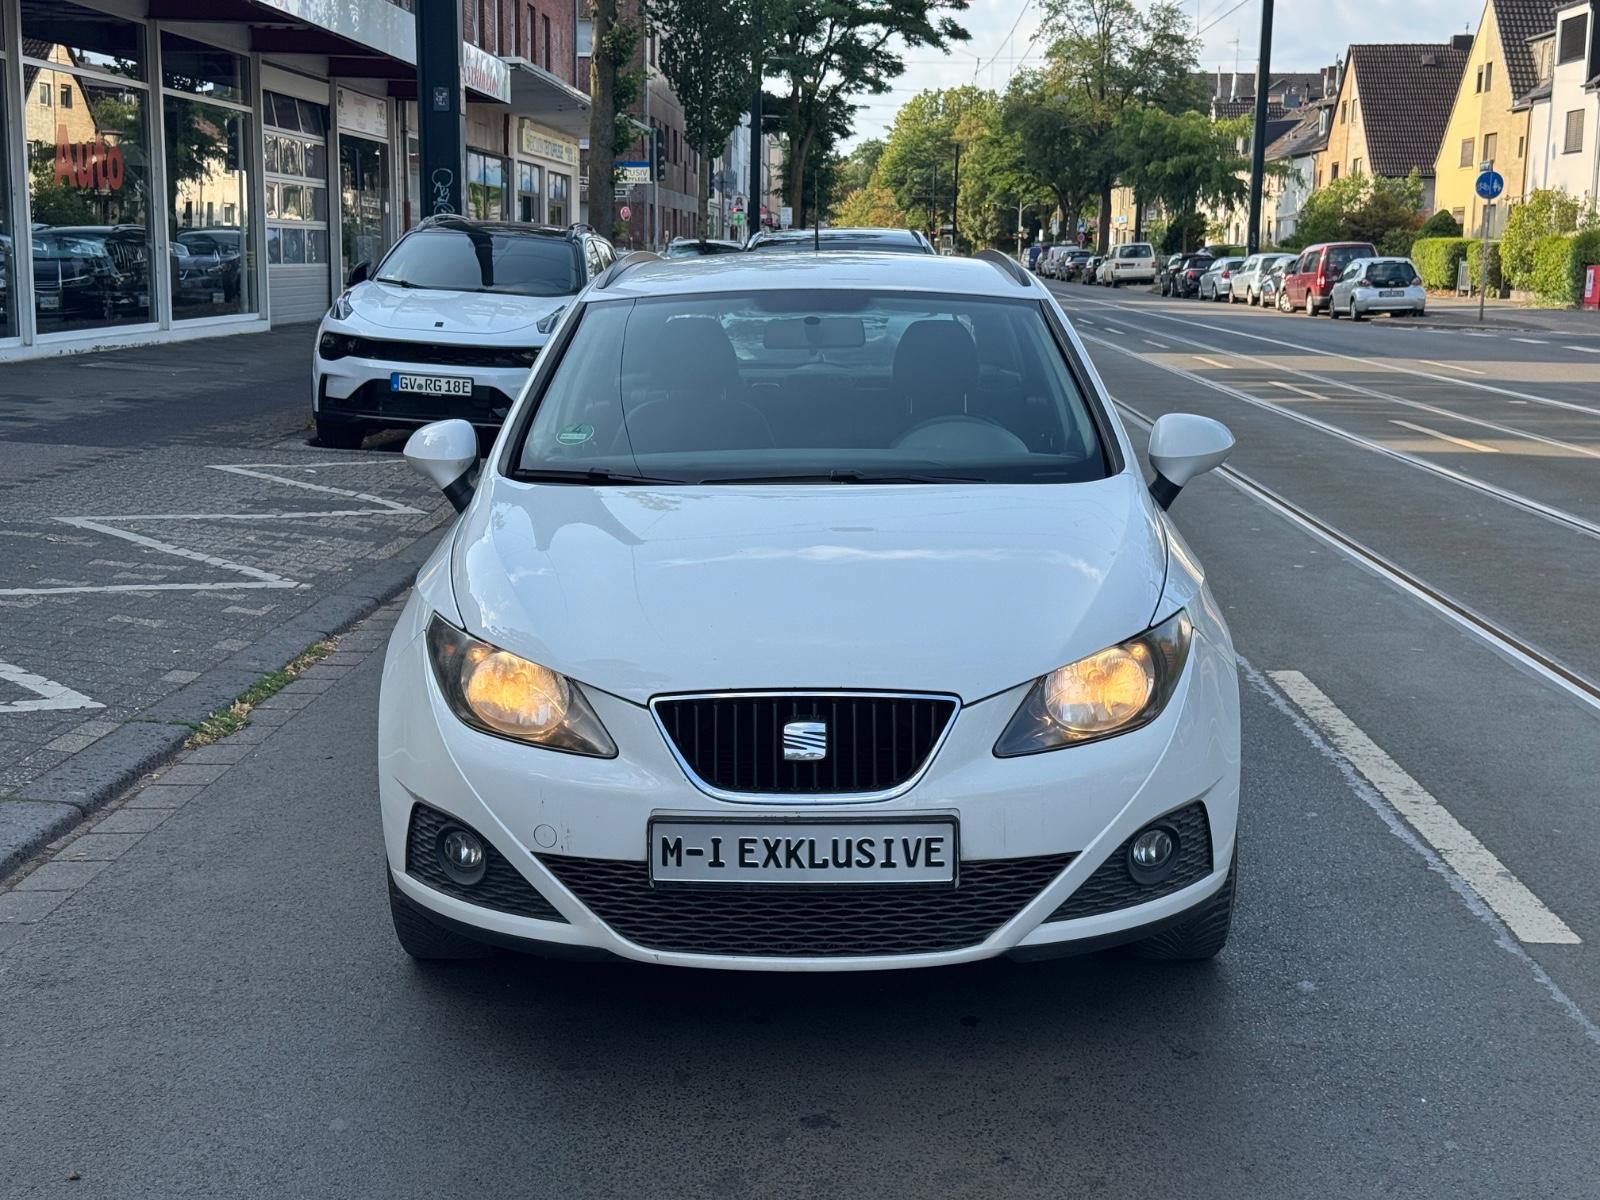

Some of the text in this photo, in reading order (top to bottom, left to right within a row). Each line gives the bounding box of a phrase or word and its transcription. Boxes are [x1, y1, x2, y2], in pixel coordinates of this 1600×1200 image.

[54, 123, 123, 190] Auto
[400, 376, 471, 394] GV RG 18E
[661, 836, 945, 870] M-I EXKLUSIVE
